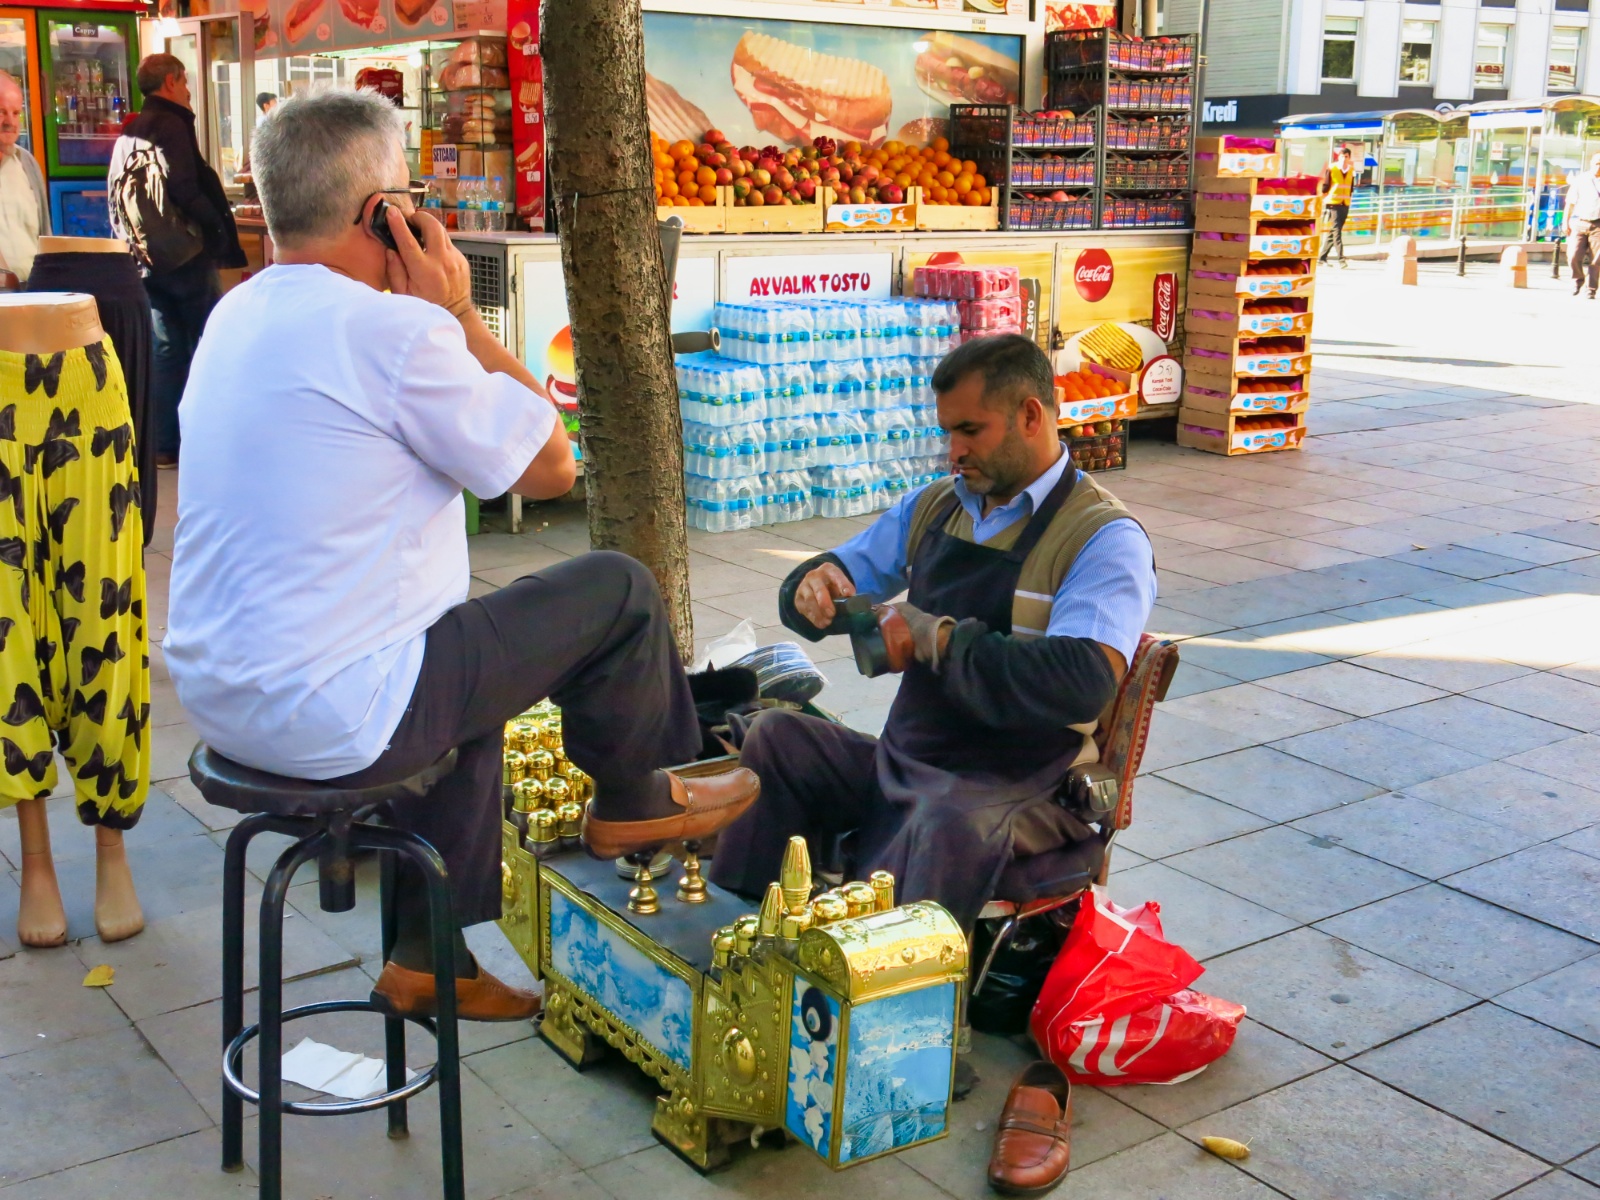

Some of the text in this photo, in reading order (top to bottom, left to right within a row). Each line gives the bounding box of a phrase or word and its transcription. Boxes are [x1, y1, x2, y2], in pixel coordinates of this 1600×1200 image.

[1203, 101, 1237, 122] Kredi
[433, 147, 456, 162] SETCARD
[750, 272, 871, 296] AYVALIK TOSTU
[1026, 300, 1035, 330] zero
